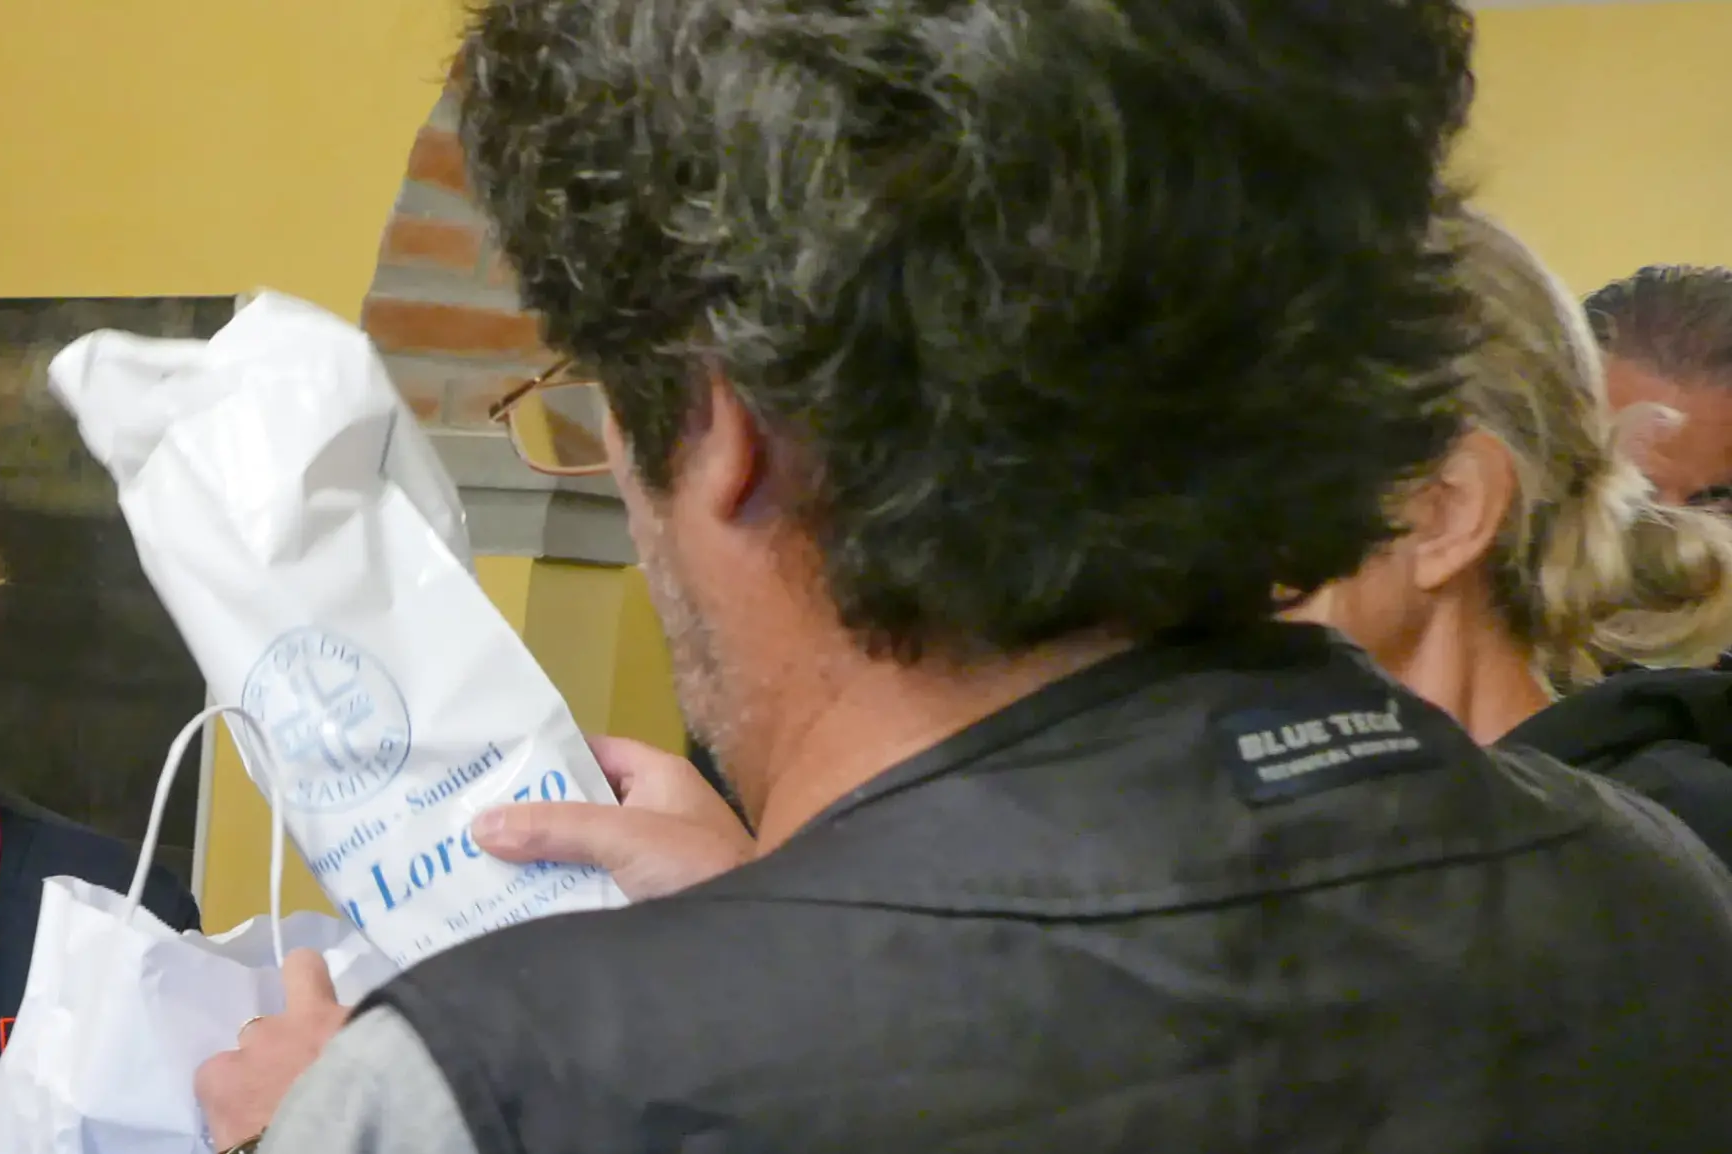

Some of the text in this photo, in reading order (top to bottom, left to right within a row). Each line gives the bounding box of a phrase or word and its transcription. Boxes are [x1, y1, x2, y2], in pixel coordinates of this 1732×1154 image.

[1238, 719, 1332, 761] BLUE
[405, 741, 505, 811] Sanitari
[371, 769, 567, 913] Loreo
